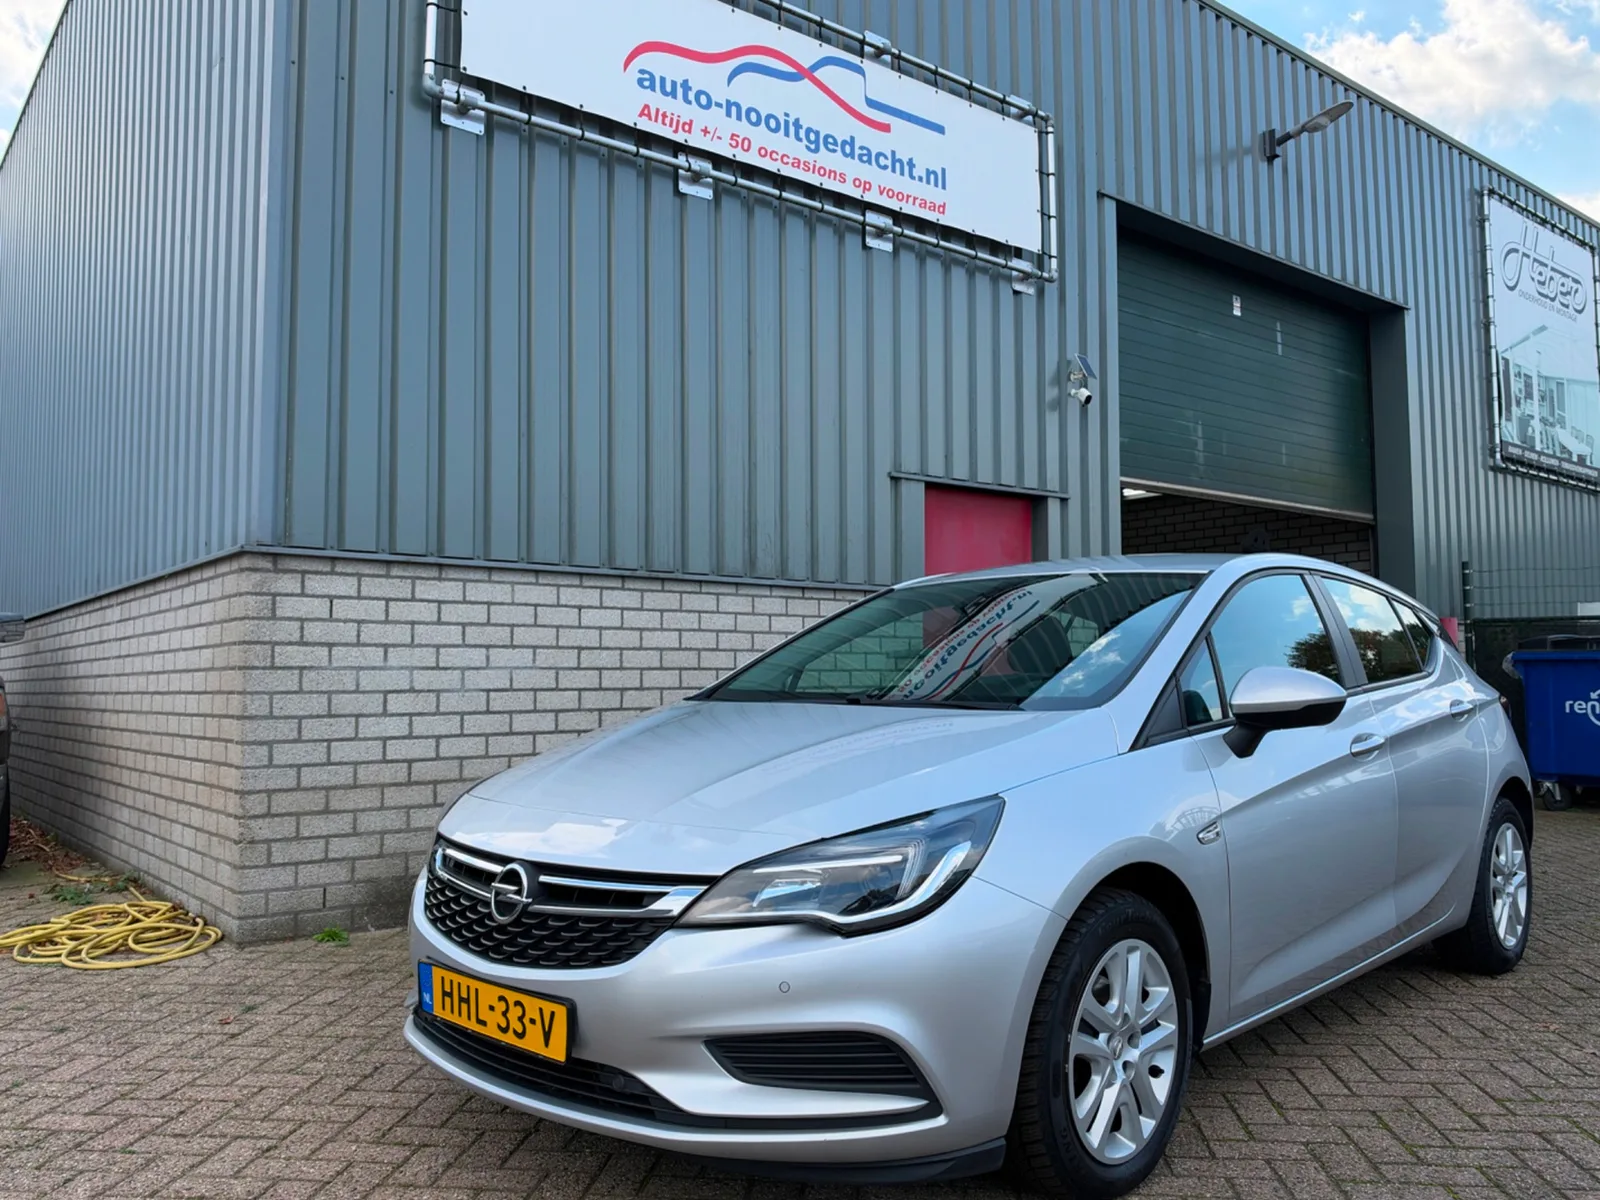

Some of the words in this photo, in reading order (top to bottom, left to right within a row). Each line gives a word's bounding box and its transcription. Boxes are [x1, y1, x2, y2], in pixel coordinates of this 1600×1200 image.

[636, 68, 947, 191] auto-nooitgedacht.nl
[638, 103, 694, 135] Altijd
[700, 125, 723, 142] +/-
[728, 132, 752, 153] 50
[757, 146, 847, 184] occasions
[852, 177, 872, 194] op
[878, 184, 946, 216] voorraad
[423, 991, 433, 1004] NL
[441, 976, 555, 1049] HHL-33-V
